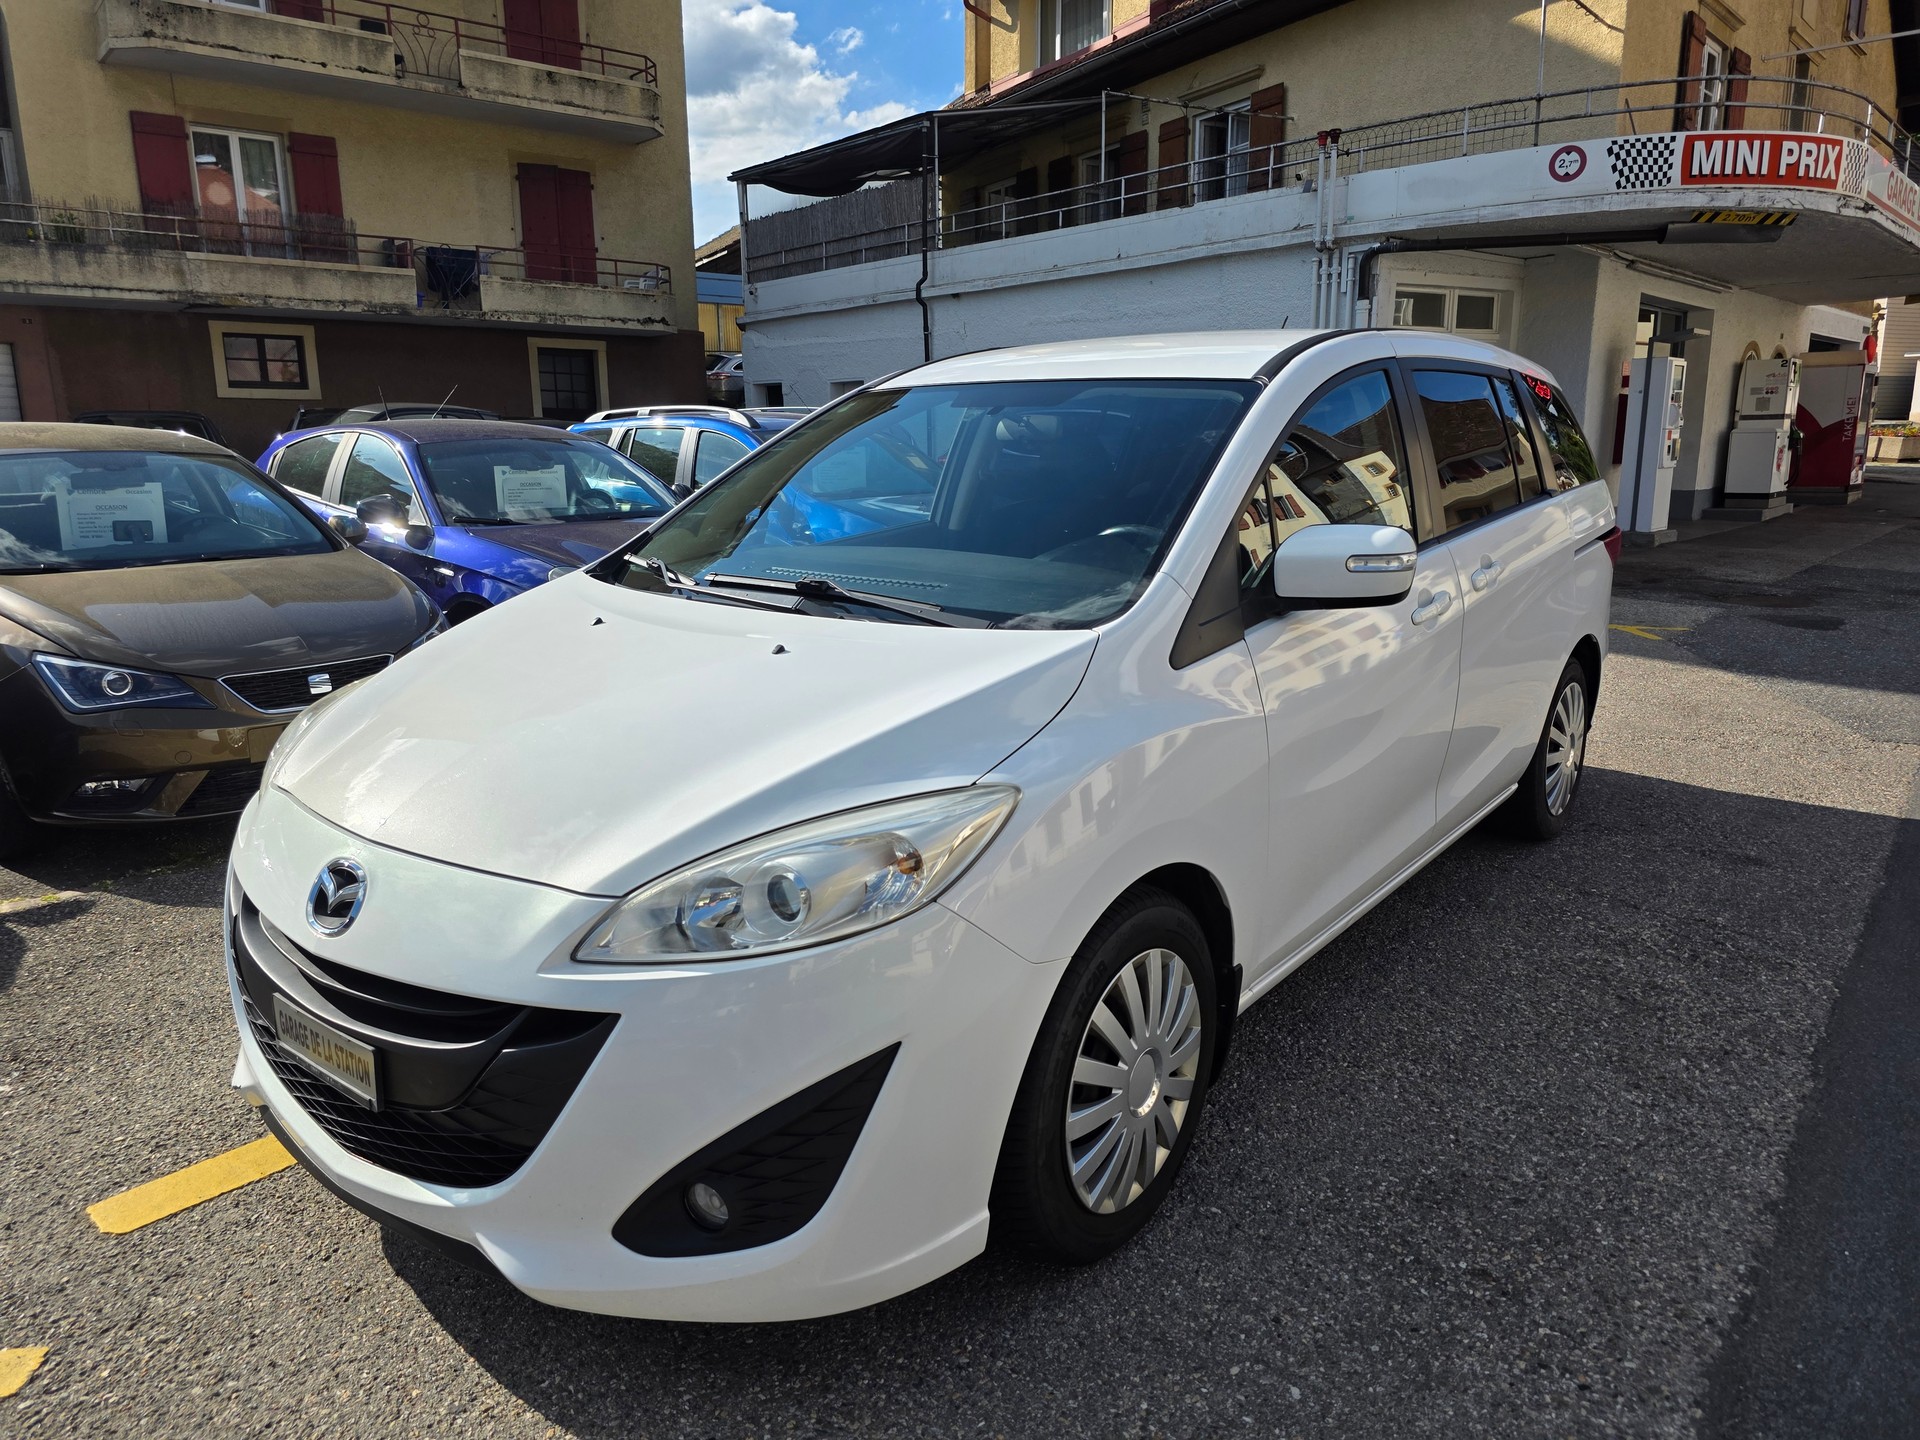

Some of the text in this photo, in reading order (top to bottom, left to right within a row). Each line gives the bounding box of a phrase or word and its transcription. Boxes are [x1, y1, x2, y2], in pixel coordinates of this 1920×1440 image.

[1690, 139, 1841, 180] MINI PRIX
[1887, 170, 1918, 217] GARAGE
[1841, 397, 1857, 442] TAKE ME!
[279, 1009, 310, 1051] GARAGE
[310, 1029, 322, 1057] DE
[322, 1036, 334, 1066] LA
[334, 1043, 372, 1088] STATION
